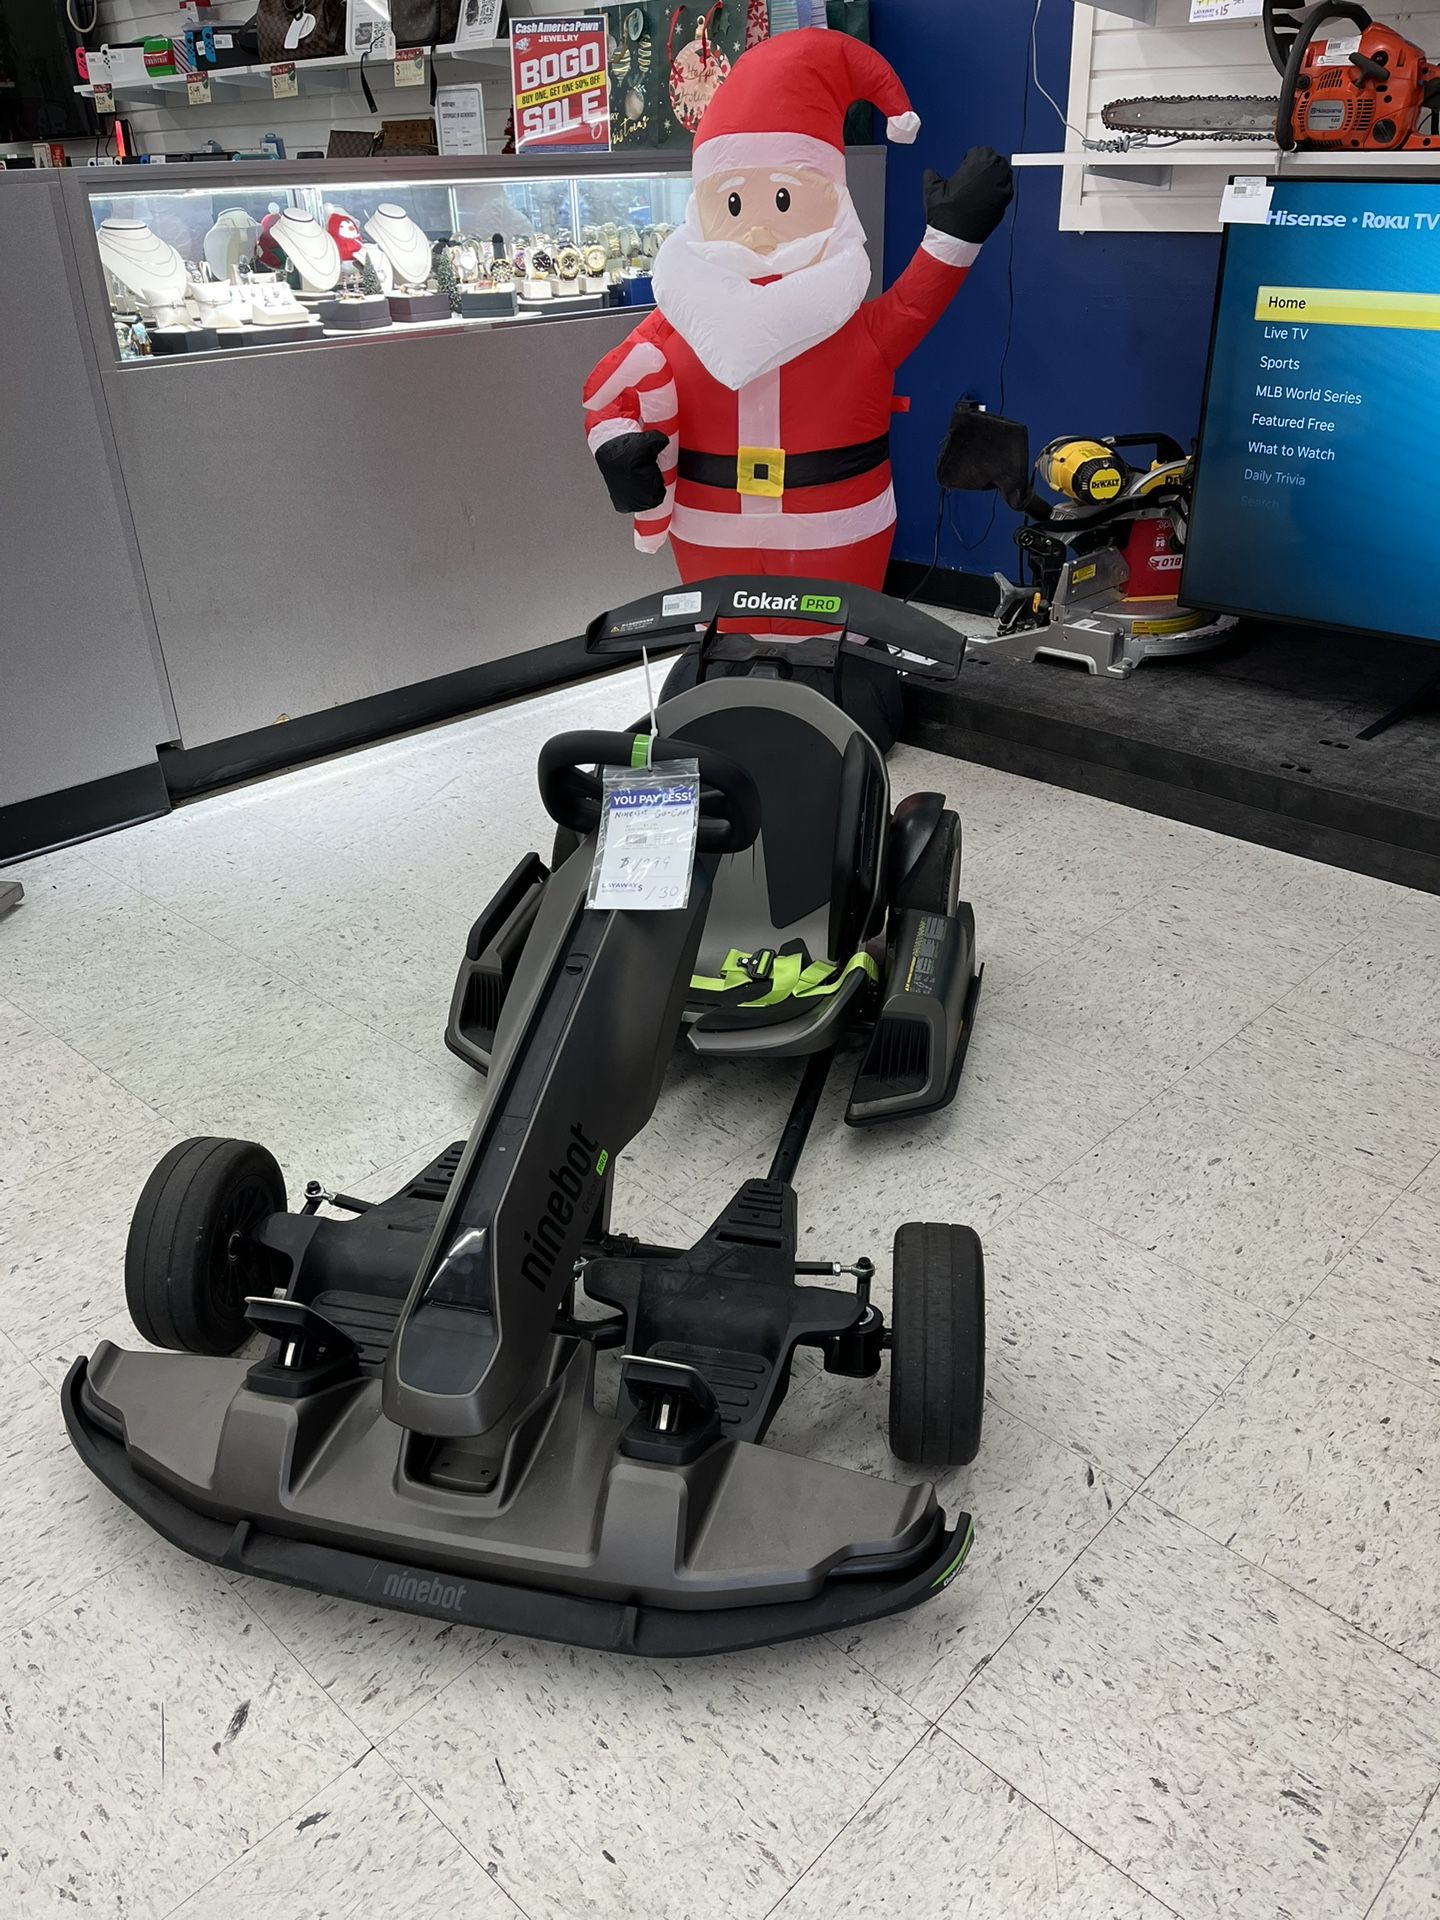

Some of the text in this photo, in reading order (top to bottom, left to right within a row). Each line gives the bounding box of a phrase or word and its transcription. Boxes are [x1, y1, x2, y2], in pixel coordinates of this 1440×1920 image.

[515, 20, 599, 34] Cash America Pawn
[538, 34, 579, 43] JEWELRY
[520, 41, 600, 90] BOGO
[521, 94, 533, 105] BUY
[549, 86, 560, 96] GET
[561, 83, 574, 94] ONE
[575, 78, 589, 90] 50%
[590, 74, 601, 85] OFF
[522, 88, 602, 137] SALE
[610, 112, 620, 121] RY
[1265, 210, 1440, 230] Hisense Roku TV
[1268, 296, 1307, 310] Home
[1264, 326, 1310, 341] Live TV
[1259, 355, 1301, 371] Sports
[1255, 385, 1363, 405] MLB World Series
[1251, 413, 1336, 432] Featured Free
[1247, 441, 1336, 461] What to Watch
[1244, 468, 1307, 487] Daily Trivia
[1161, 557, 1182, 568] BLO
[733, 590, 836, 611] Gokart PRO
[613, 791, 692, 806] YOU PAY LESS!
[520, 1121, 600, 1293] ninebot
[382, 1570, 468, 1612] ninebot
